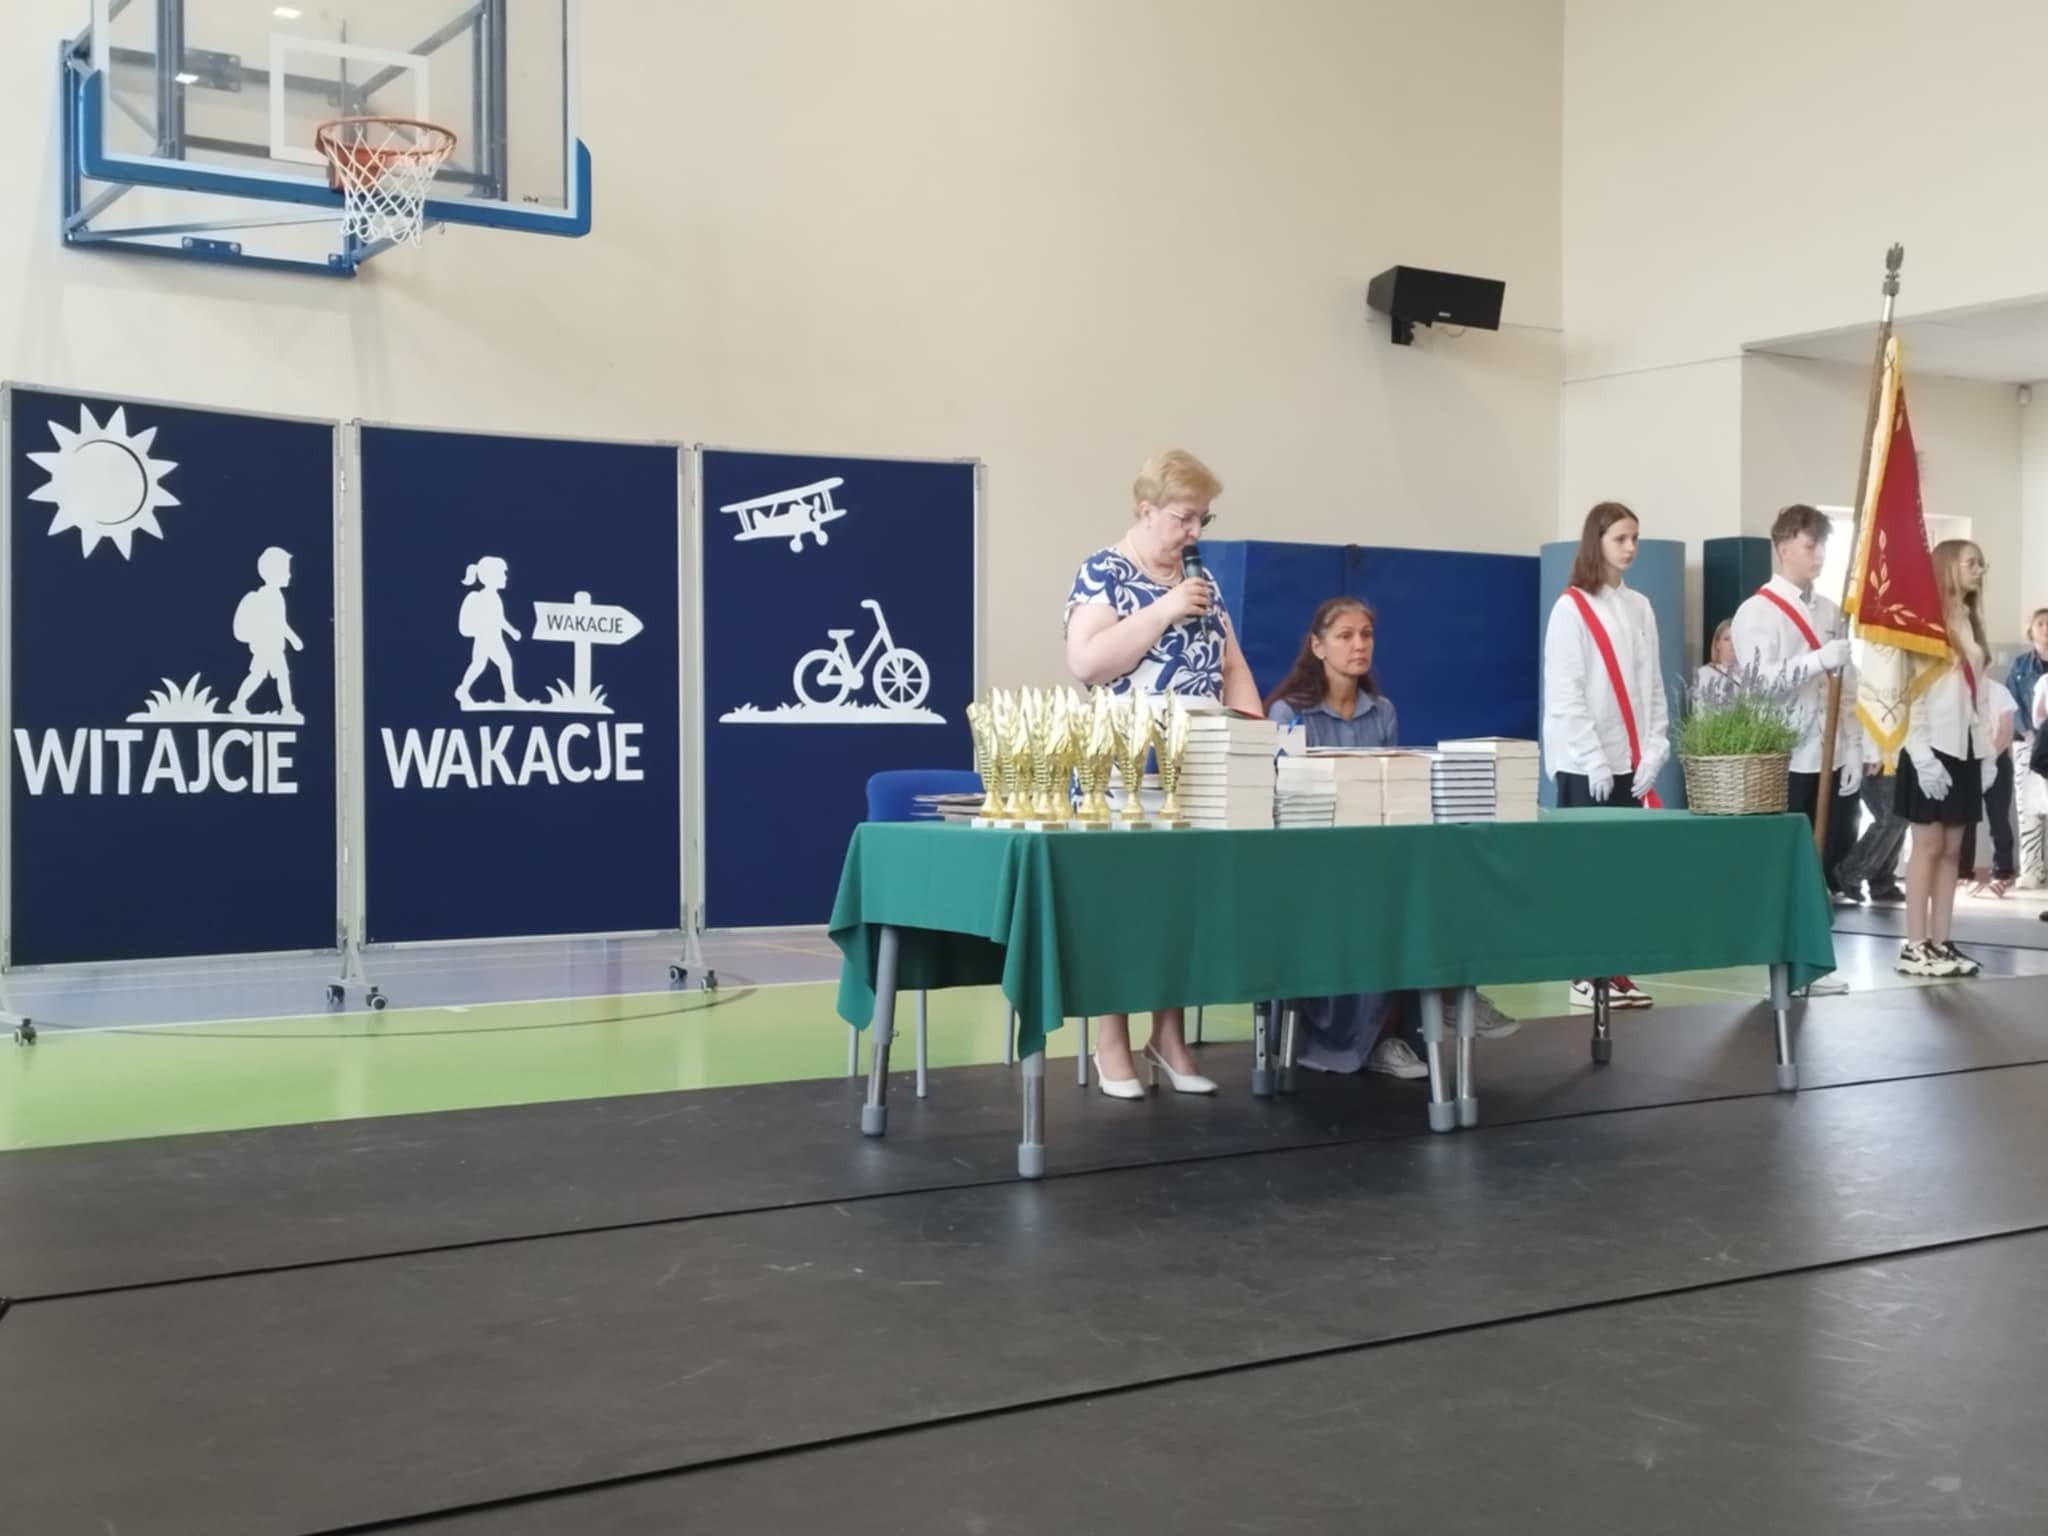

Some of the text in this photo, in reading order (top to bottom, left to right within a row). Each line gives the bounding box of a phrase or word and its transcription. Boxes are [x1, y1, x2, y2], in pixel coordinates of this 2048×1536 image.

[547, 613, 624, 634] WAKACJE
[14, 728, 298, 795] WITAJCIE
[381, 721, 644, 789] WAKACJE
